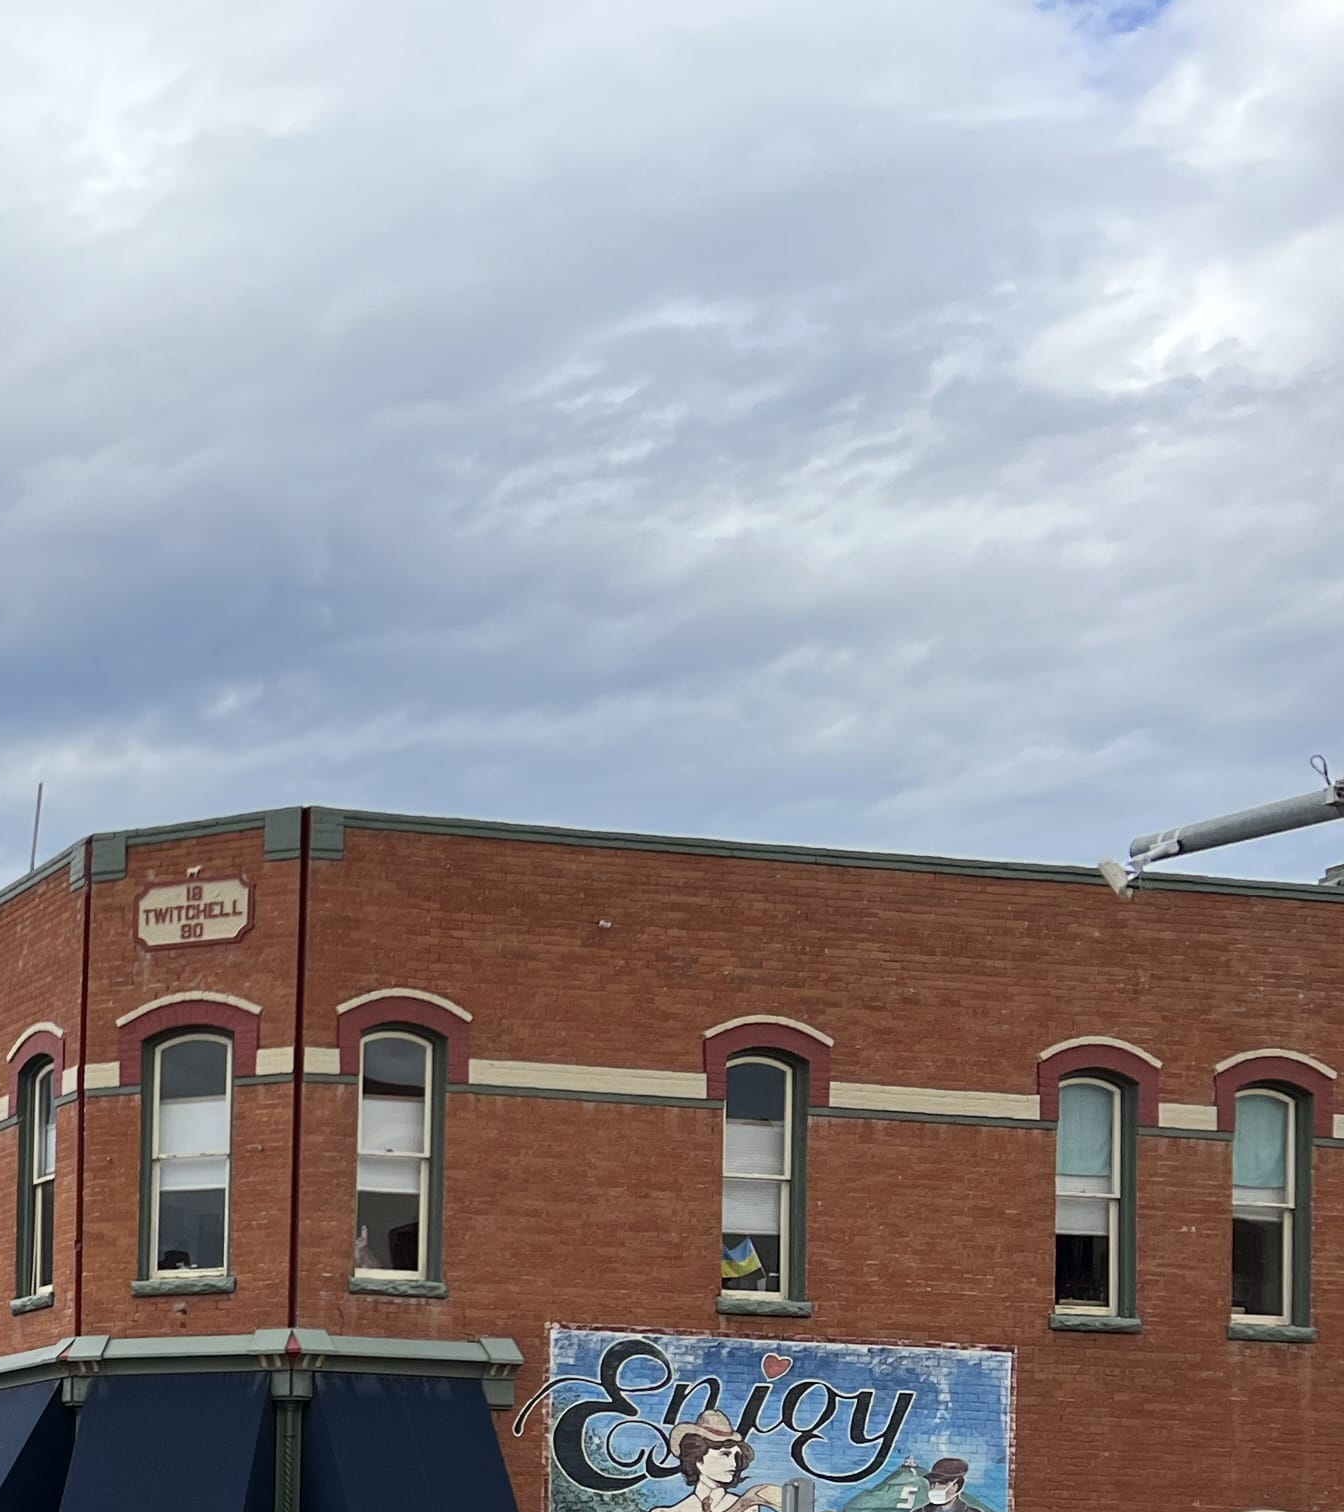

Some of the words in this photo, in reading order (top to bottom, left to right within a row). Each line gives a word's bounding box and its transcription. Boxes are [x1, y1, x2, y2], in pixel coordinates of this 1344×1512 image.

[186, 885, 203, 902] 18
[143, 899, 243, 926] TWITCHELL
[180, 923, 204, 939] 80
[512, 1337, 916, 1494] Enjoy
